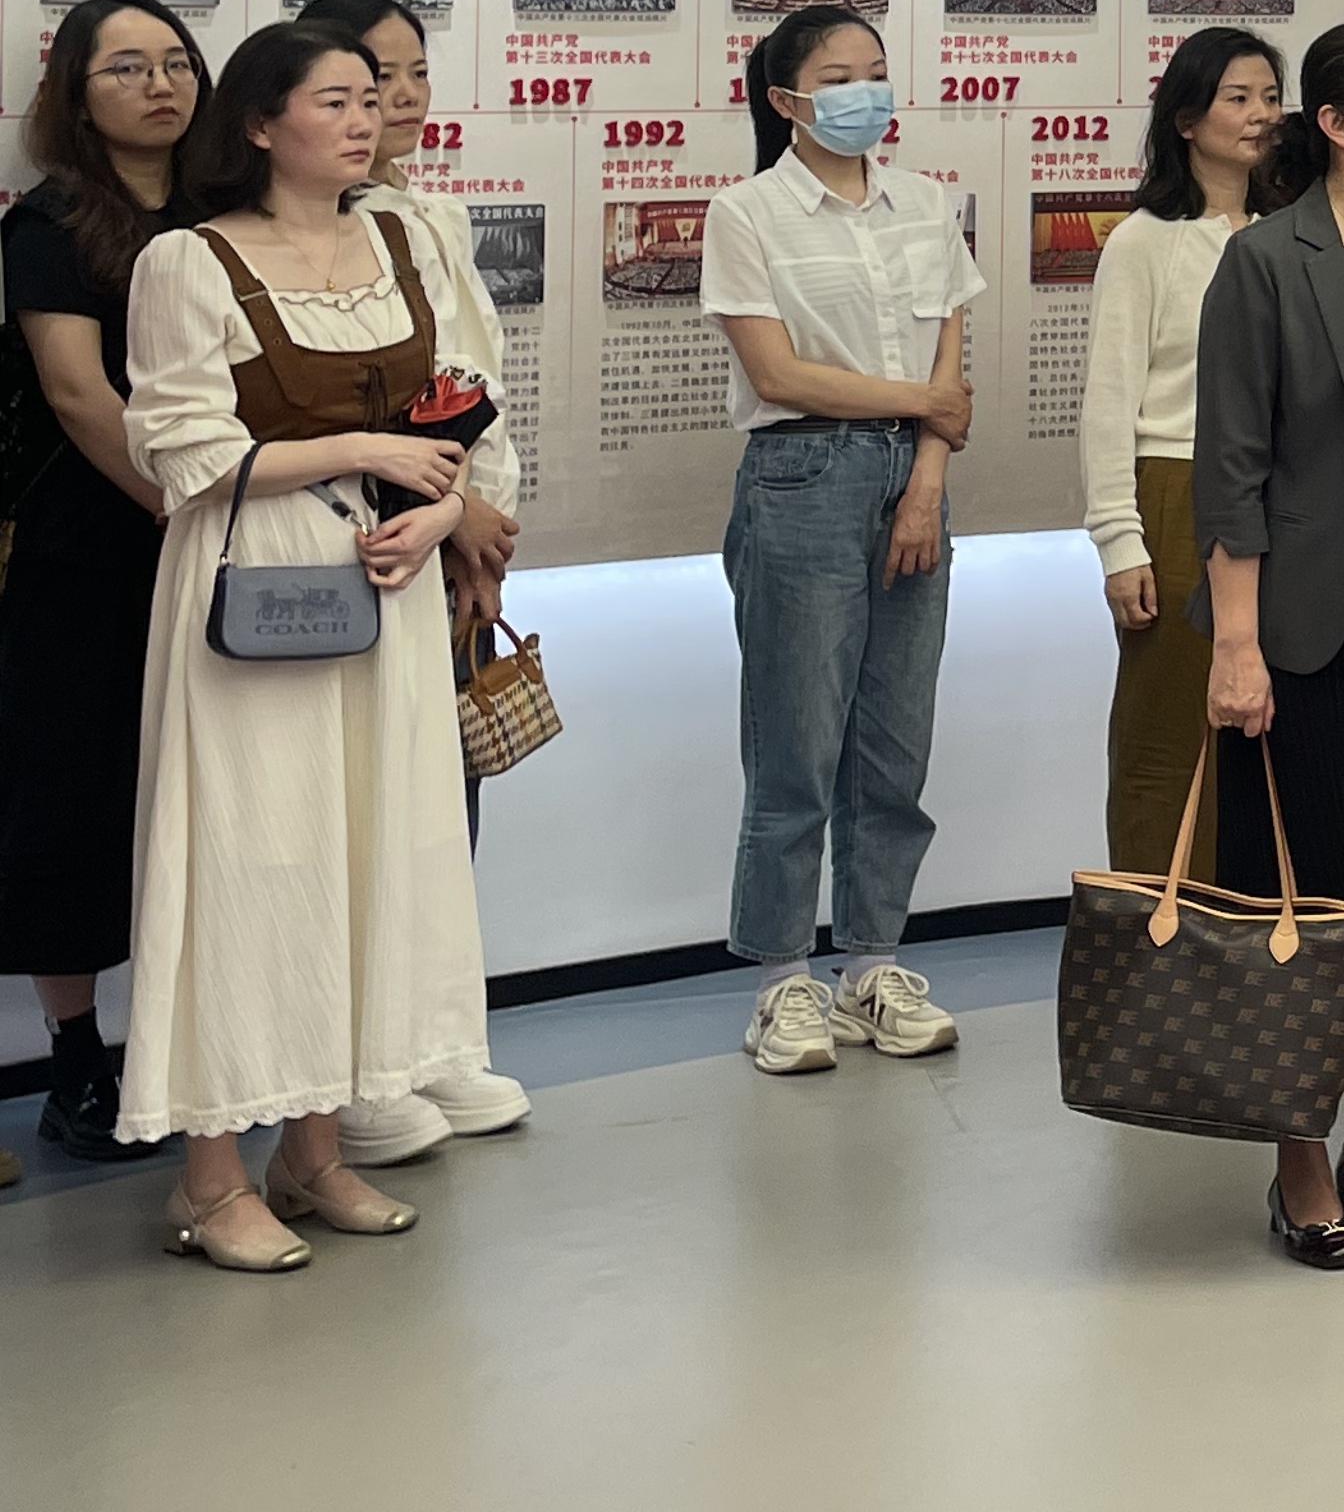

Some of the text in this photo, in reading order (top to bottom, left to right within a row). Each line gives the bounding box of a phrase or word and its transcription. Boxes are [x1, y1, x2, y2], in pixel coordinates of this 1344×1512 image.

[506, 34, 579, 48] 中国共产党
[940, 36, 1009, 48] 中国共产党
[505, 51, 651, 65] 第十三次全国代表大会
[940, 51, 1077, 64] 第十七次全国代表大会
[509, 78, 593, 105] 1987
[940, 76, 1020, 102] 2007
[604, 120, 685, 147] 1992
[1031, 115, 1109, 141] 2012
[602, 159, 674, 174] 中国共产党
[1031, 153, 1099, 165] 中国共产党
[1031, 167, 1144, 181] 第十八次全国代表
[602, 174, 745, 190] 第十四次全国代表大会
[255, 621, 349, 636] COACH
